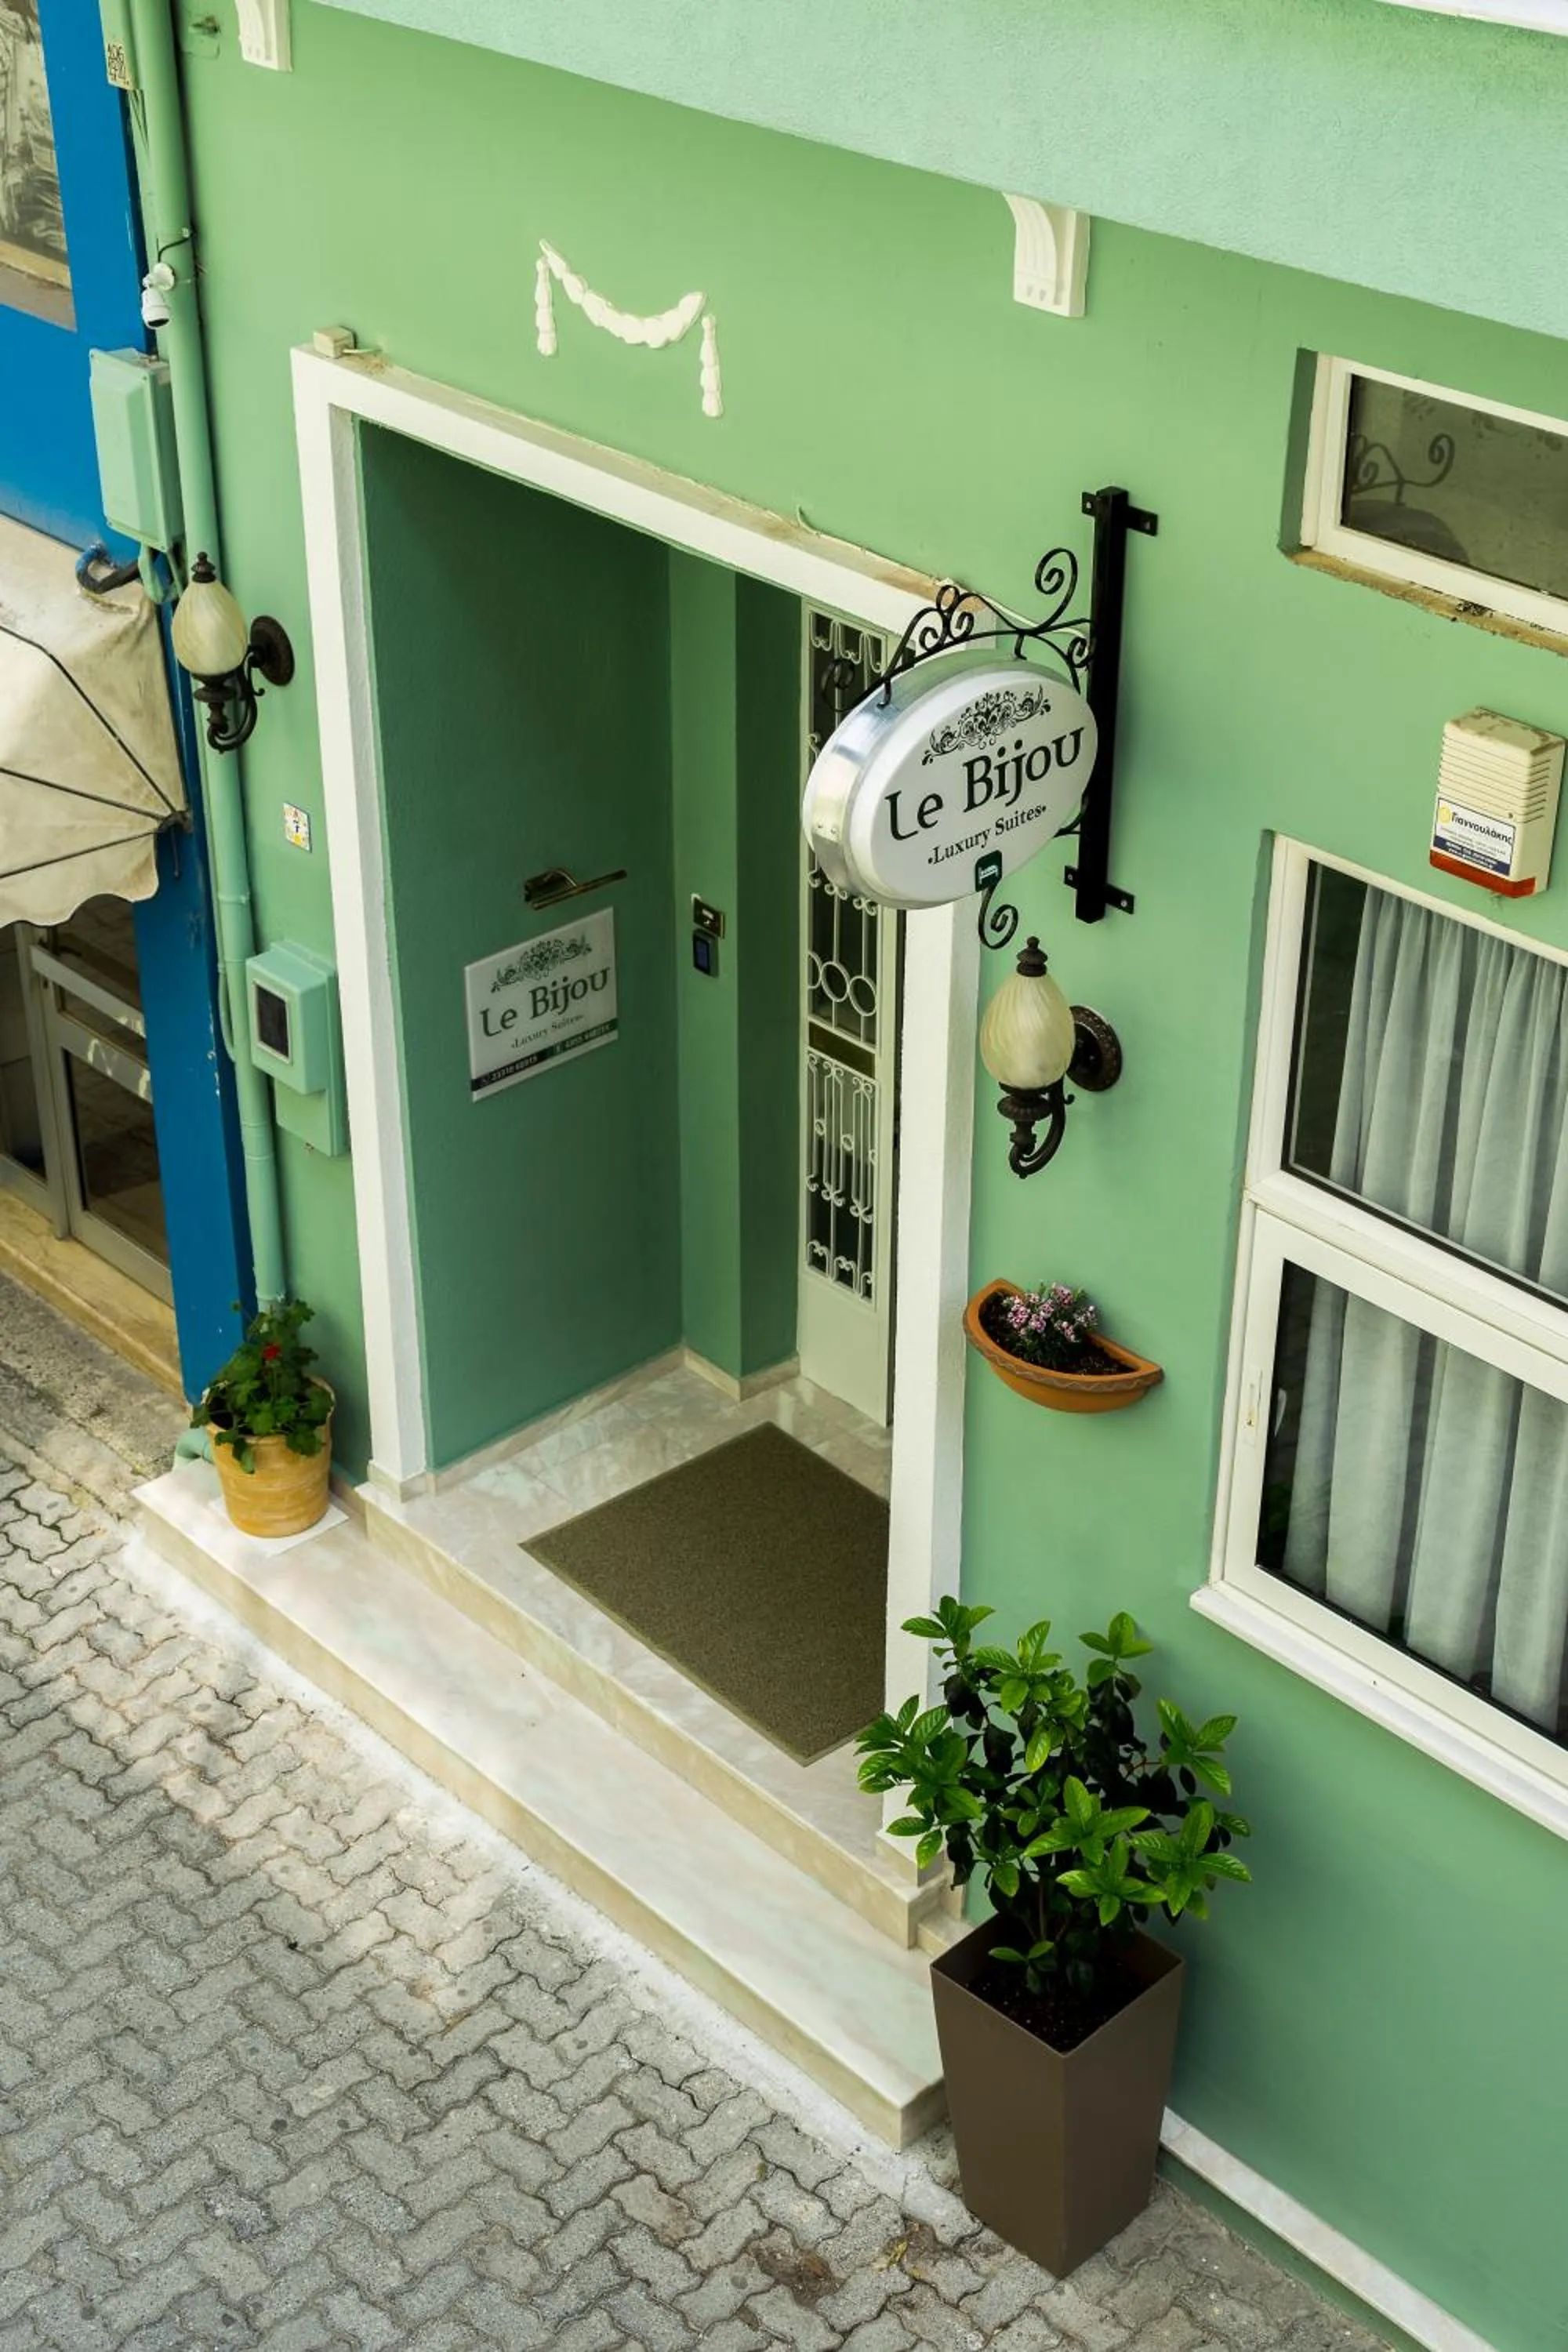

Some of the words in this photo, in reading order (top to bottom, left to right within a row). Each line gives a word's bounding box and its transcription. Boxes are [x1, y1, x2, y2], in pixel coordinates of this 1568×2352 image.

[885, 791, 944, 840] Le
[964, 728, 1084, 812] Bijou
[480, 1008, 517, 1037] Le
[529, 967, 611, 1019] Bijou
